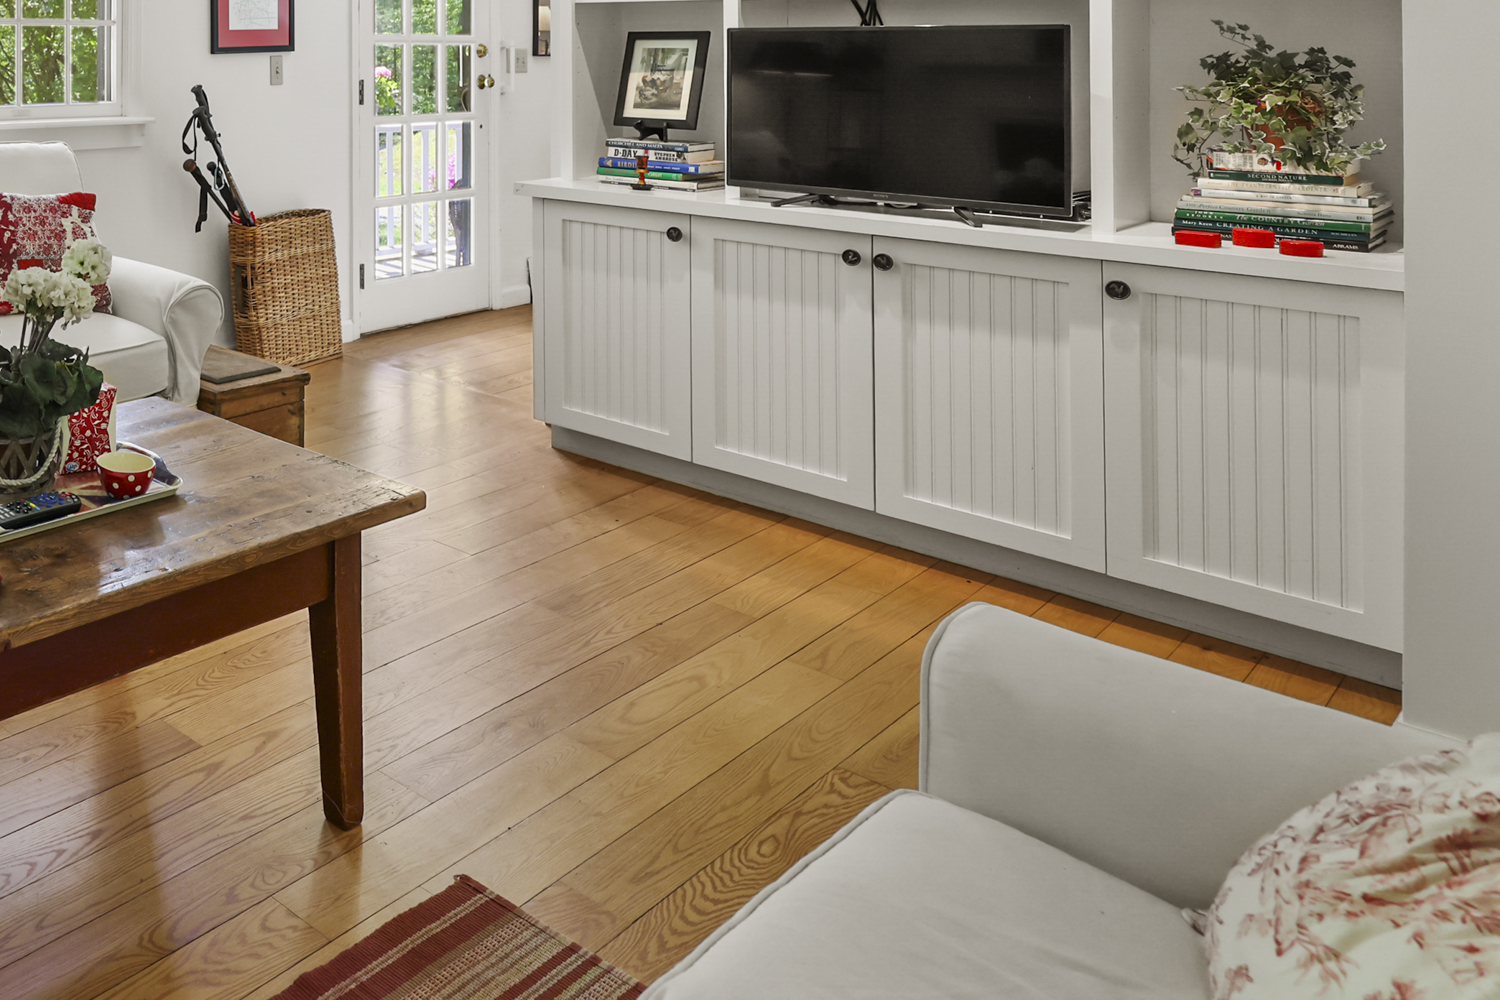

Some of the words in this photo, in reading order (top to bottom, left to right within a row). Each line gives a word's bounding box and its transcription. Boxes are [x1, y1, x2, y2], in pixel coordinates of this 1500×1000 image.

[1250, 216, 1296, 224] COUNTRY
[1216, 222, 1265, 230] CREATING
[1276, 227, 1318, 235] GARDEN
